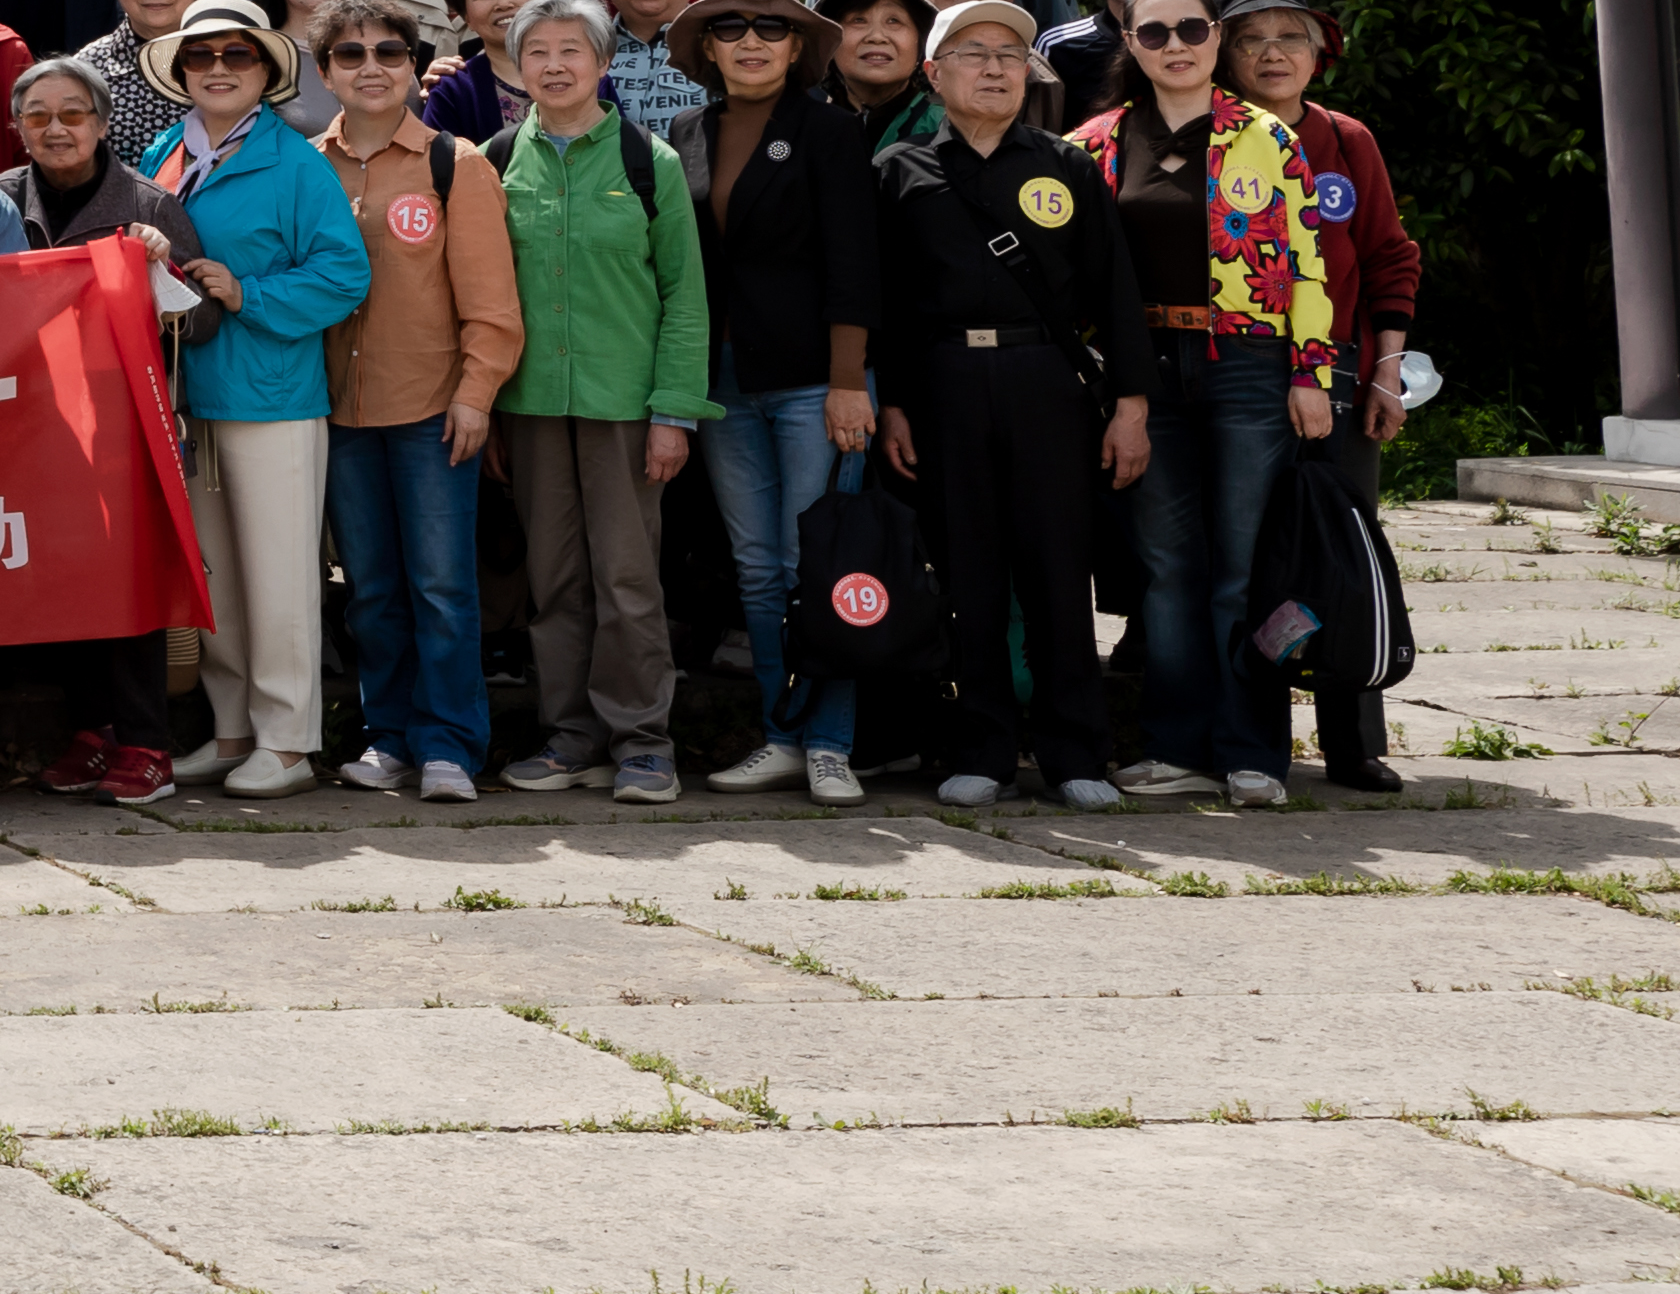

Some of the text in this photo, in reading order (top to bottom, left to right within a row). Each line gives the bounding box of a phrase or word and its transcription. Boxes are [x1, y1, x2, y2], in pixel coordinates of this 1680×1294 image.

[1231, 176, 1260, 200] 41
[1324, 185, 1343, 209] 3
[1031, 189, 1062, 215] 15
[397, 205, 429, 232] 15
[842, 586, 878, 613] 19
